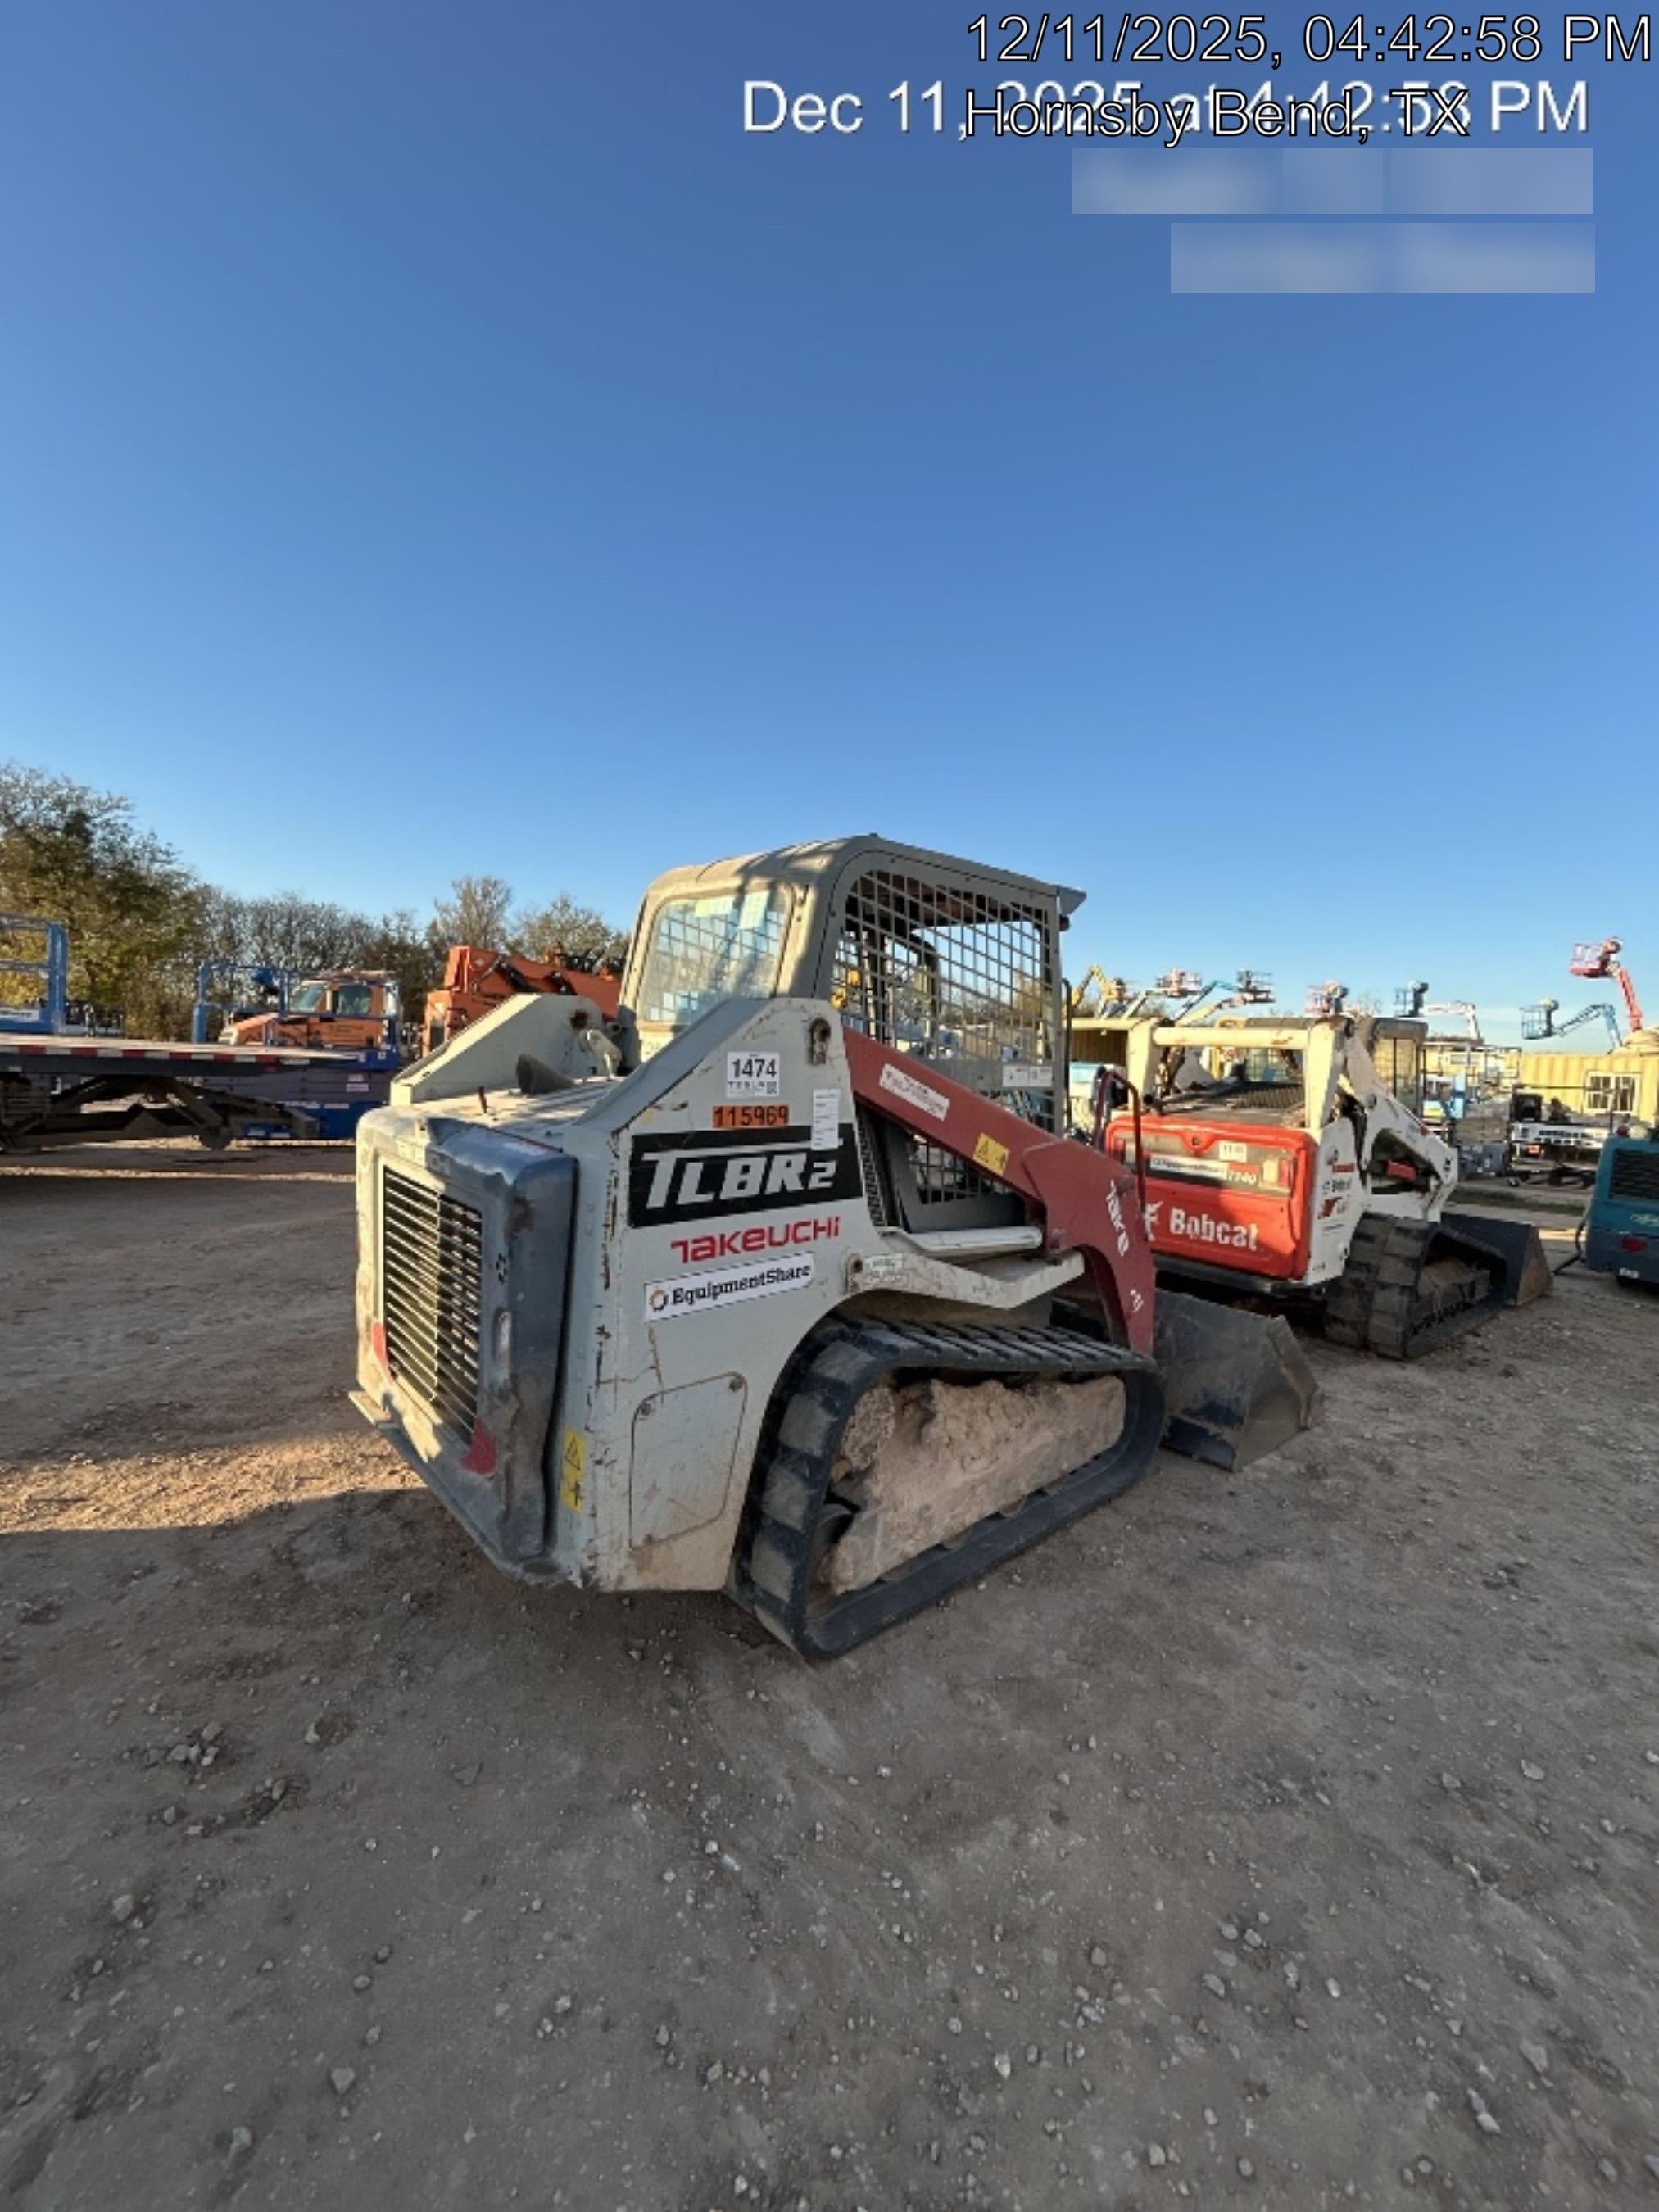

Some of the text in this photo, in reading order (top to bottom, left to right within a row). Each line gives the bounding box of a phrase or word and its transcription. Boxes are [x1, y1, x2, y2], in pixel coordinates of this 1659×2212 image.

[732, 1058, 777, 1077] 1474
[714, 1104, 790, 1127] 115969
[1169, 1206, 1260, 1252] Bobcat
[671, 1265, 810, 1305] EquipmentShare
